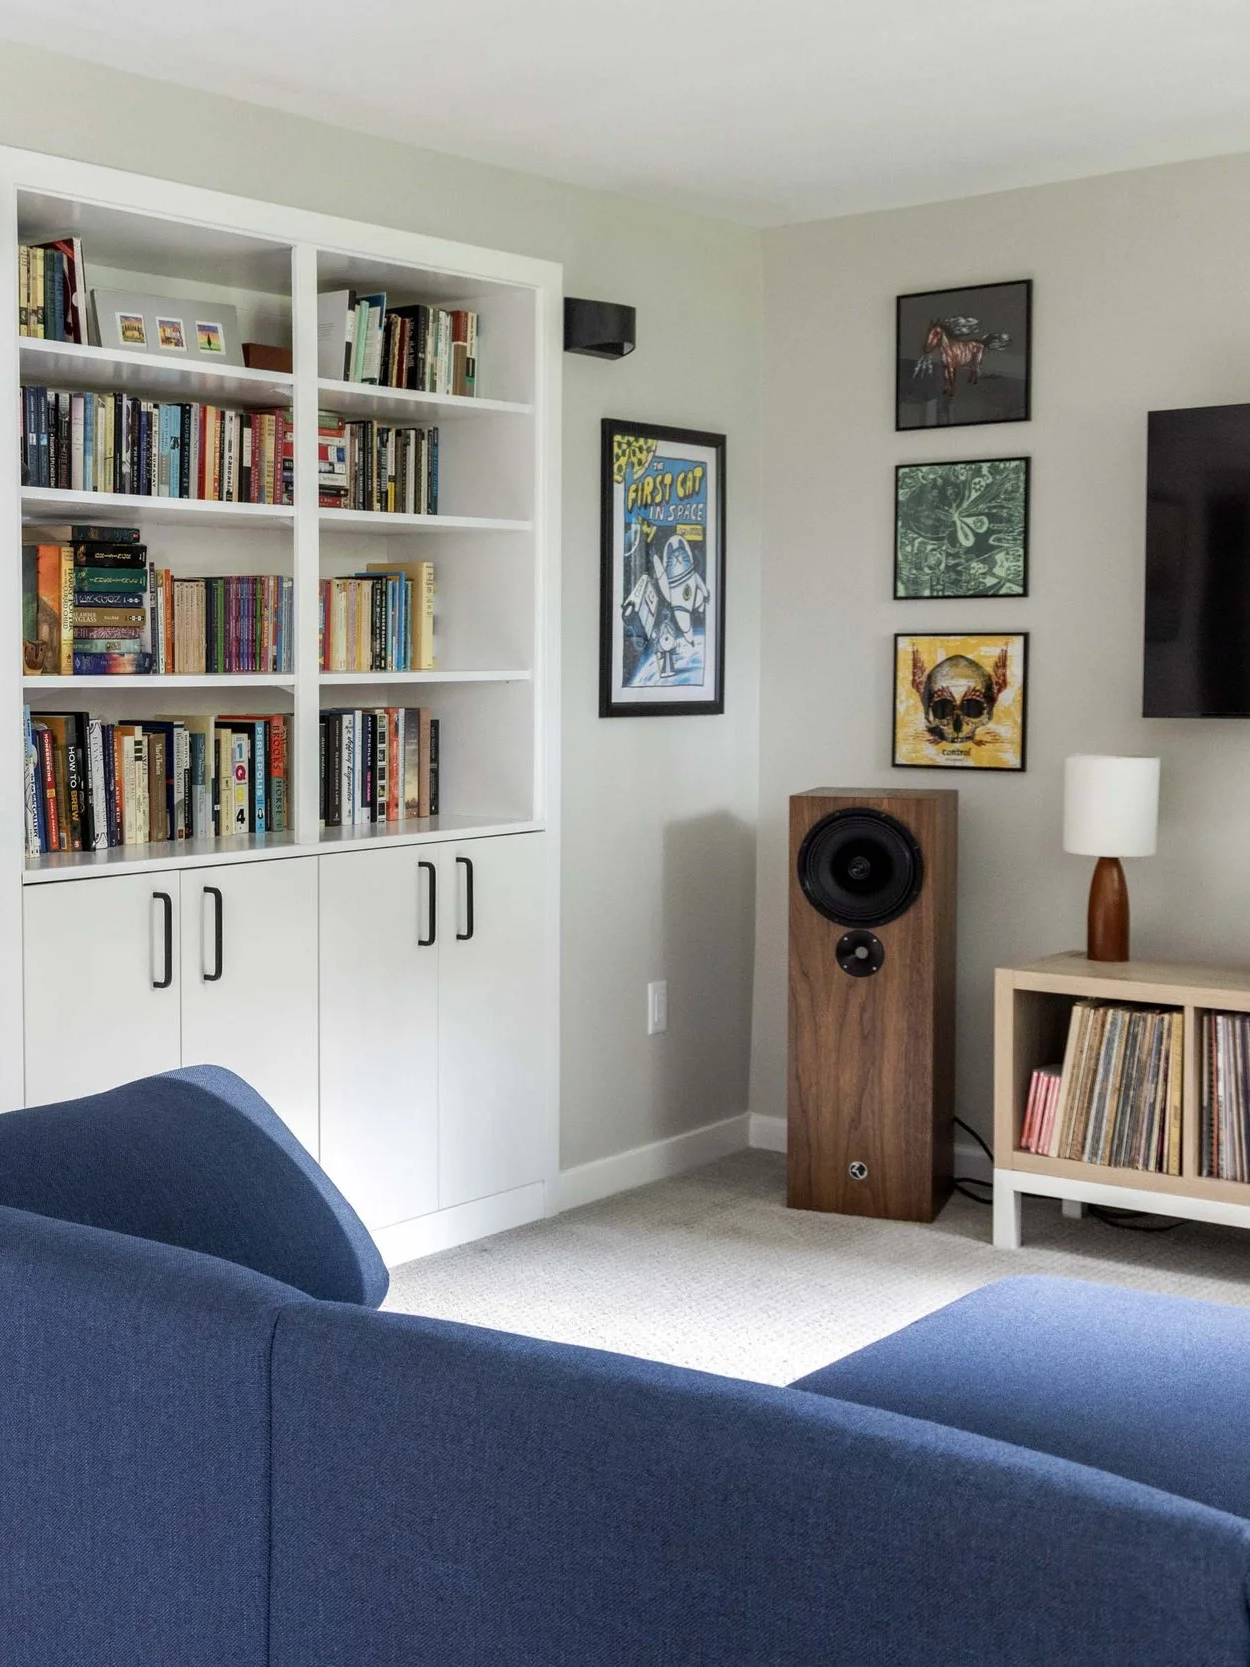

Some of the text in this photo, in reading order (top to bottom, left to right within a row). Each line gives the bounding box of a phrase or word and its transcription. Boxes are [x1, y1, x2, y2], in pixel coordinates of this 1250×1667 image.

[627, 466, 704, 513] FIRST CAT
[649, 503, 704, 521] IN SPACE
[79, 595, 121, 604] ERAGON
[44, 733, 52, 782] HOMEBREWING
[155, 743, 163, 759] Mark
[272, 725, 281, 770] BROOKS
[345, 736, 354, 764] Jeffrey
[155, 759, 163, 775] Twain
[68, 746, 79, 821] HOW TO BREW
